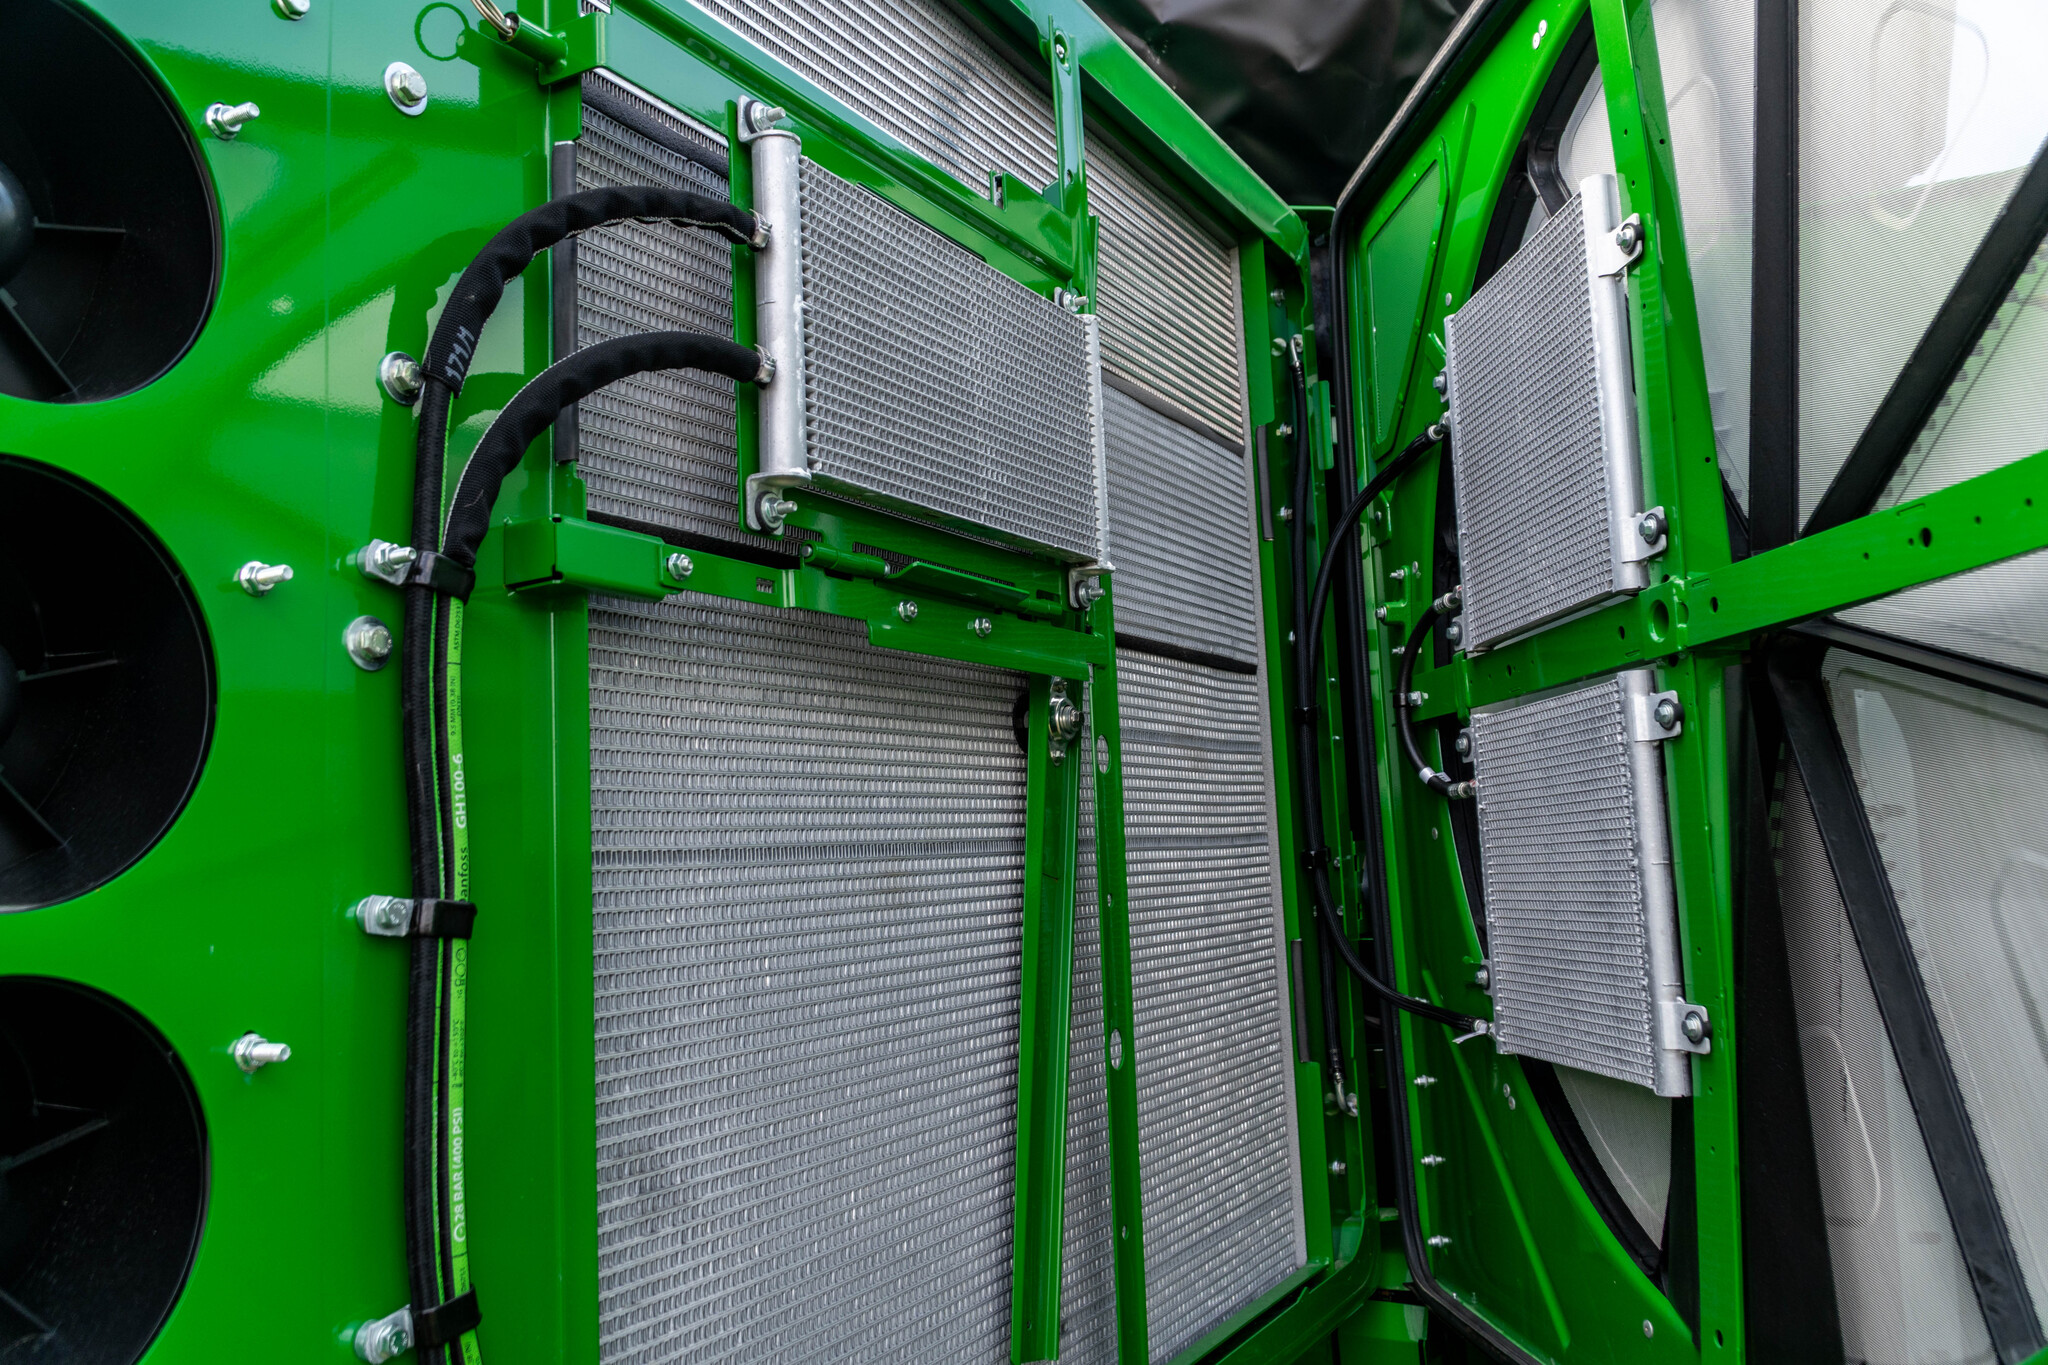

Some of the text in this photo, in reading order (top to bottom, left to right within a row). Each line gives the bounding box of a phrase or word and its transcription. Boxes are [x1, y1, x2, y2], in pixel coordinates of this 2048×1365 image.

[452, 753, 467, 829] GH100-6
[452, 1107, 465, 1223] 28 BAR (400 PSI)
